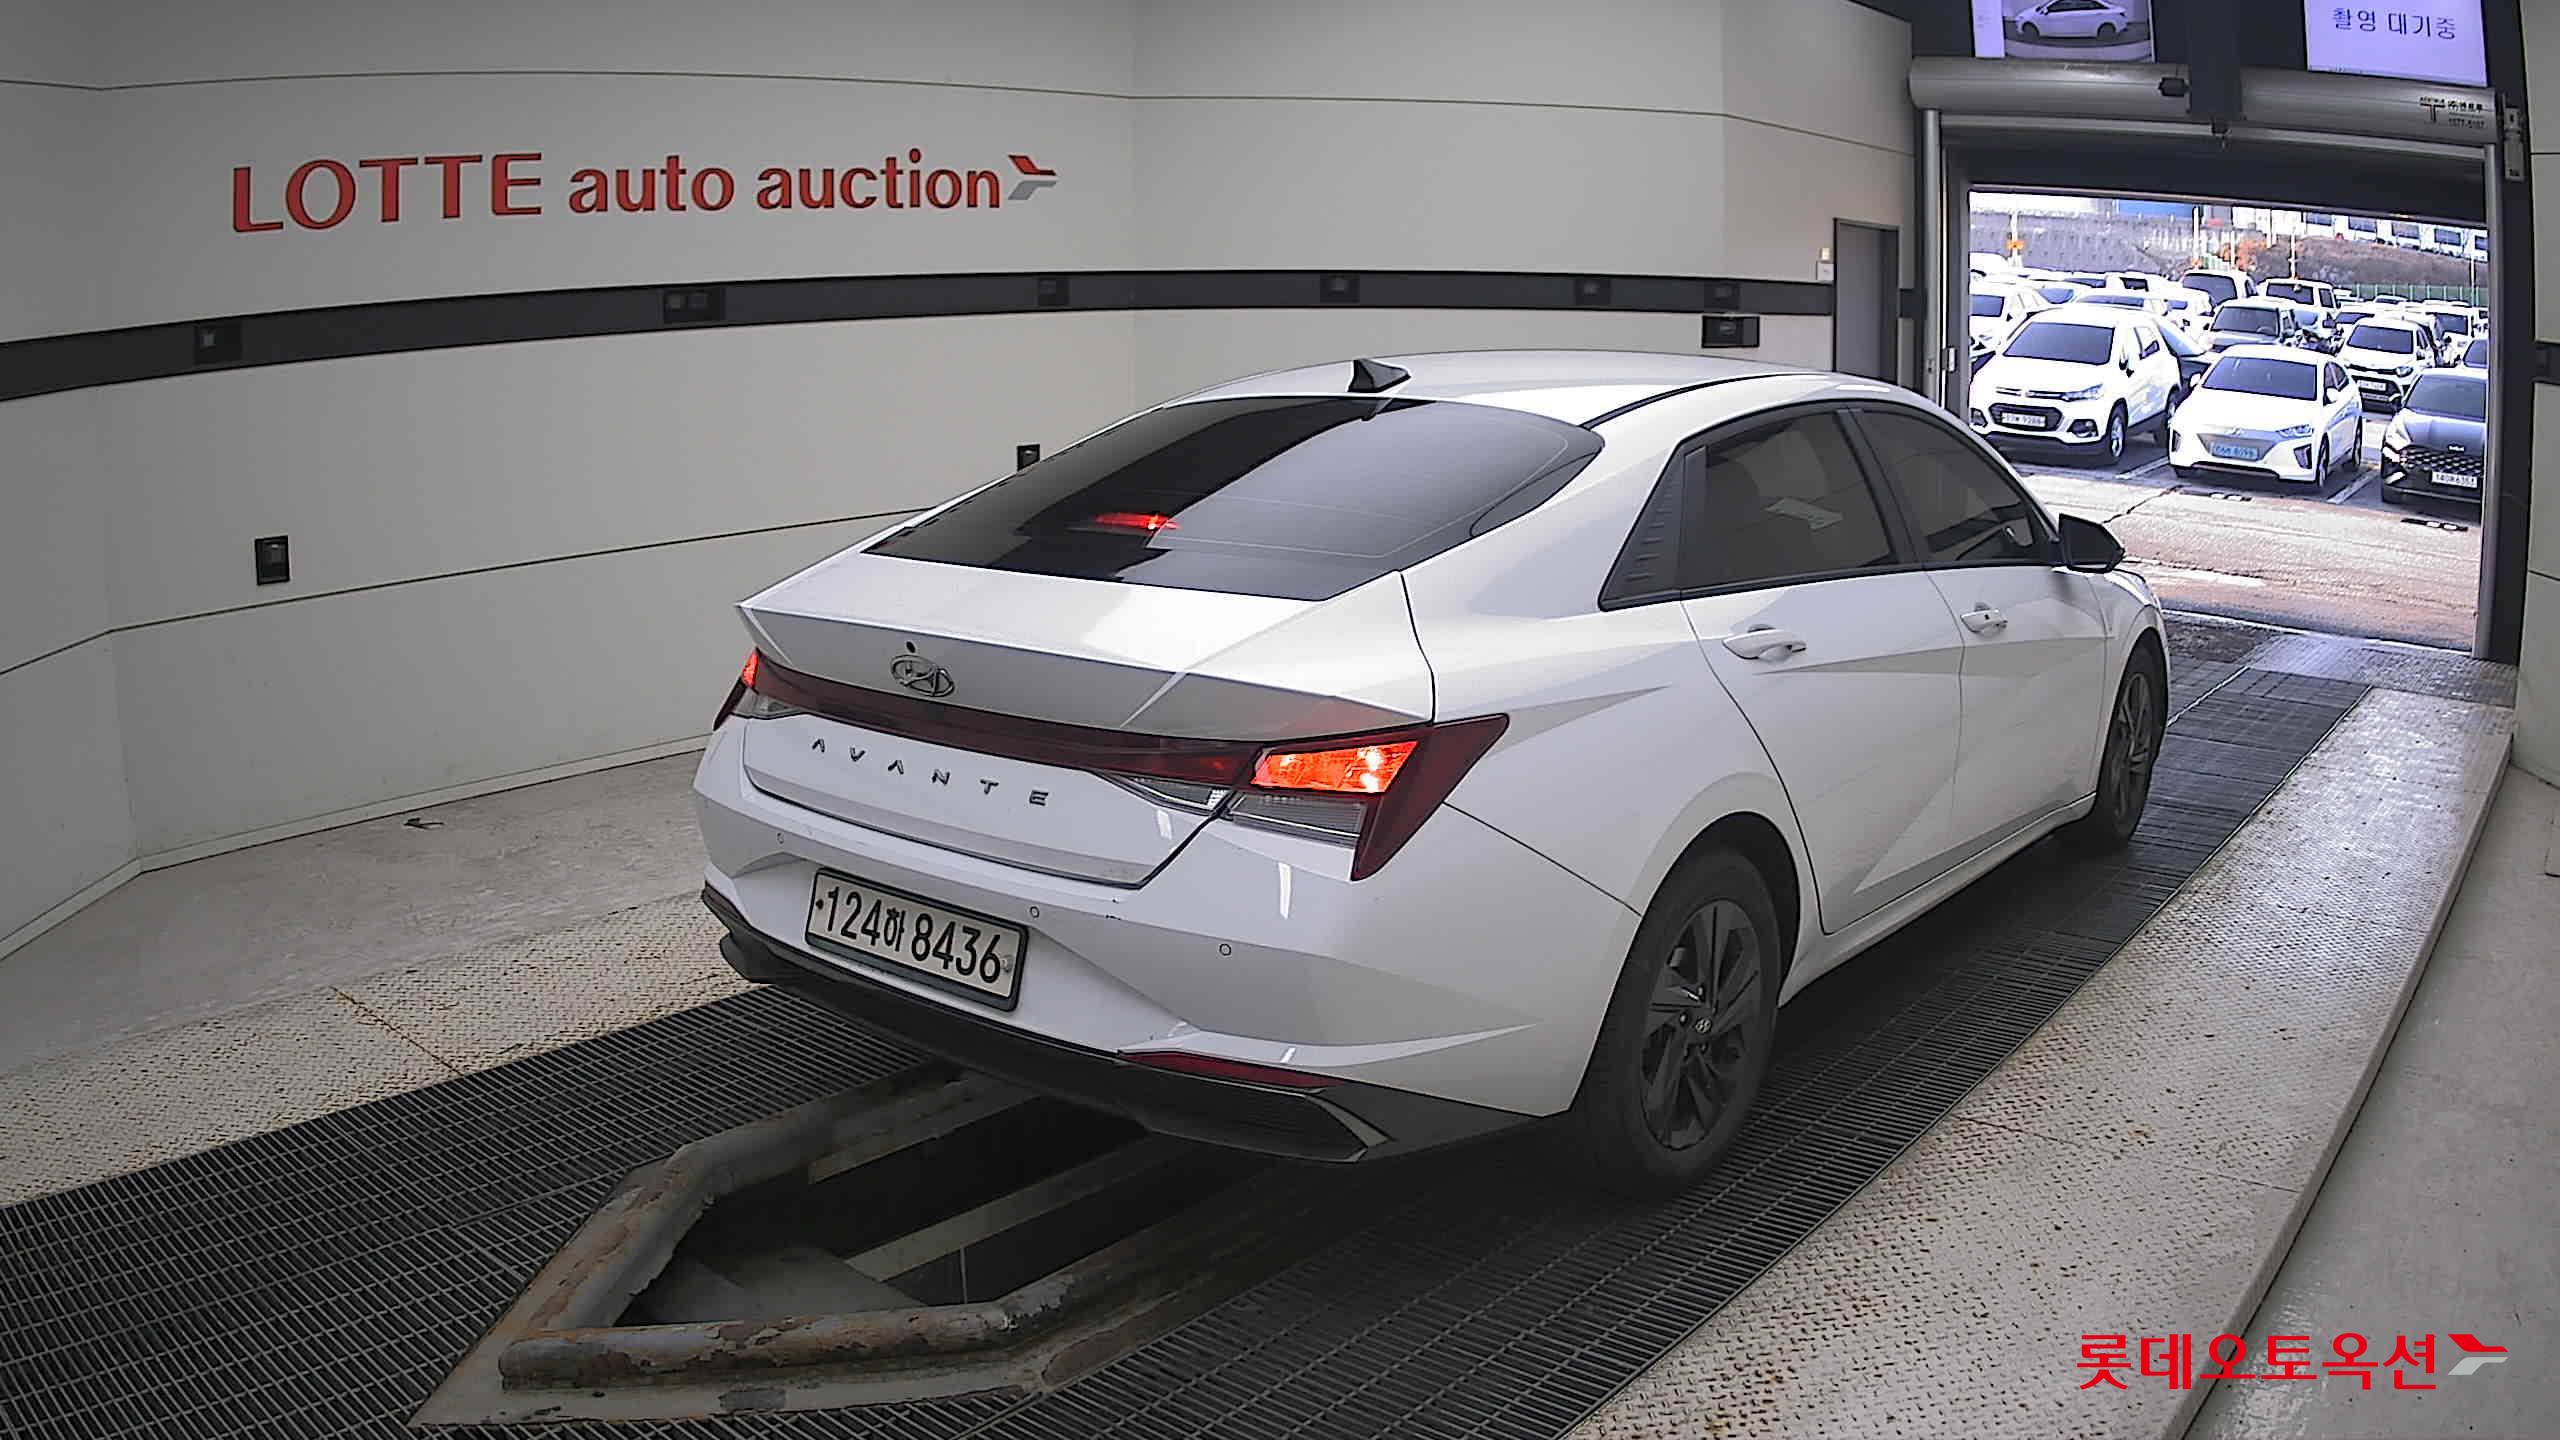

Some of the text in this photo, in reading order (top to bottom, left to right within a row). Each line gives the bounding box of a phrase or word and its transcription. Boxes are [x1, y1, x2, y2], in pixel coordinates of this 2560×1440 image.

[2332, 8, 2456, 40] 촬영 대기중
[232, 149, 1001, 232] LOTTE auto auction
[812, 738, 1049, 806] AVANTE
